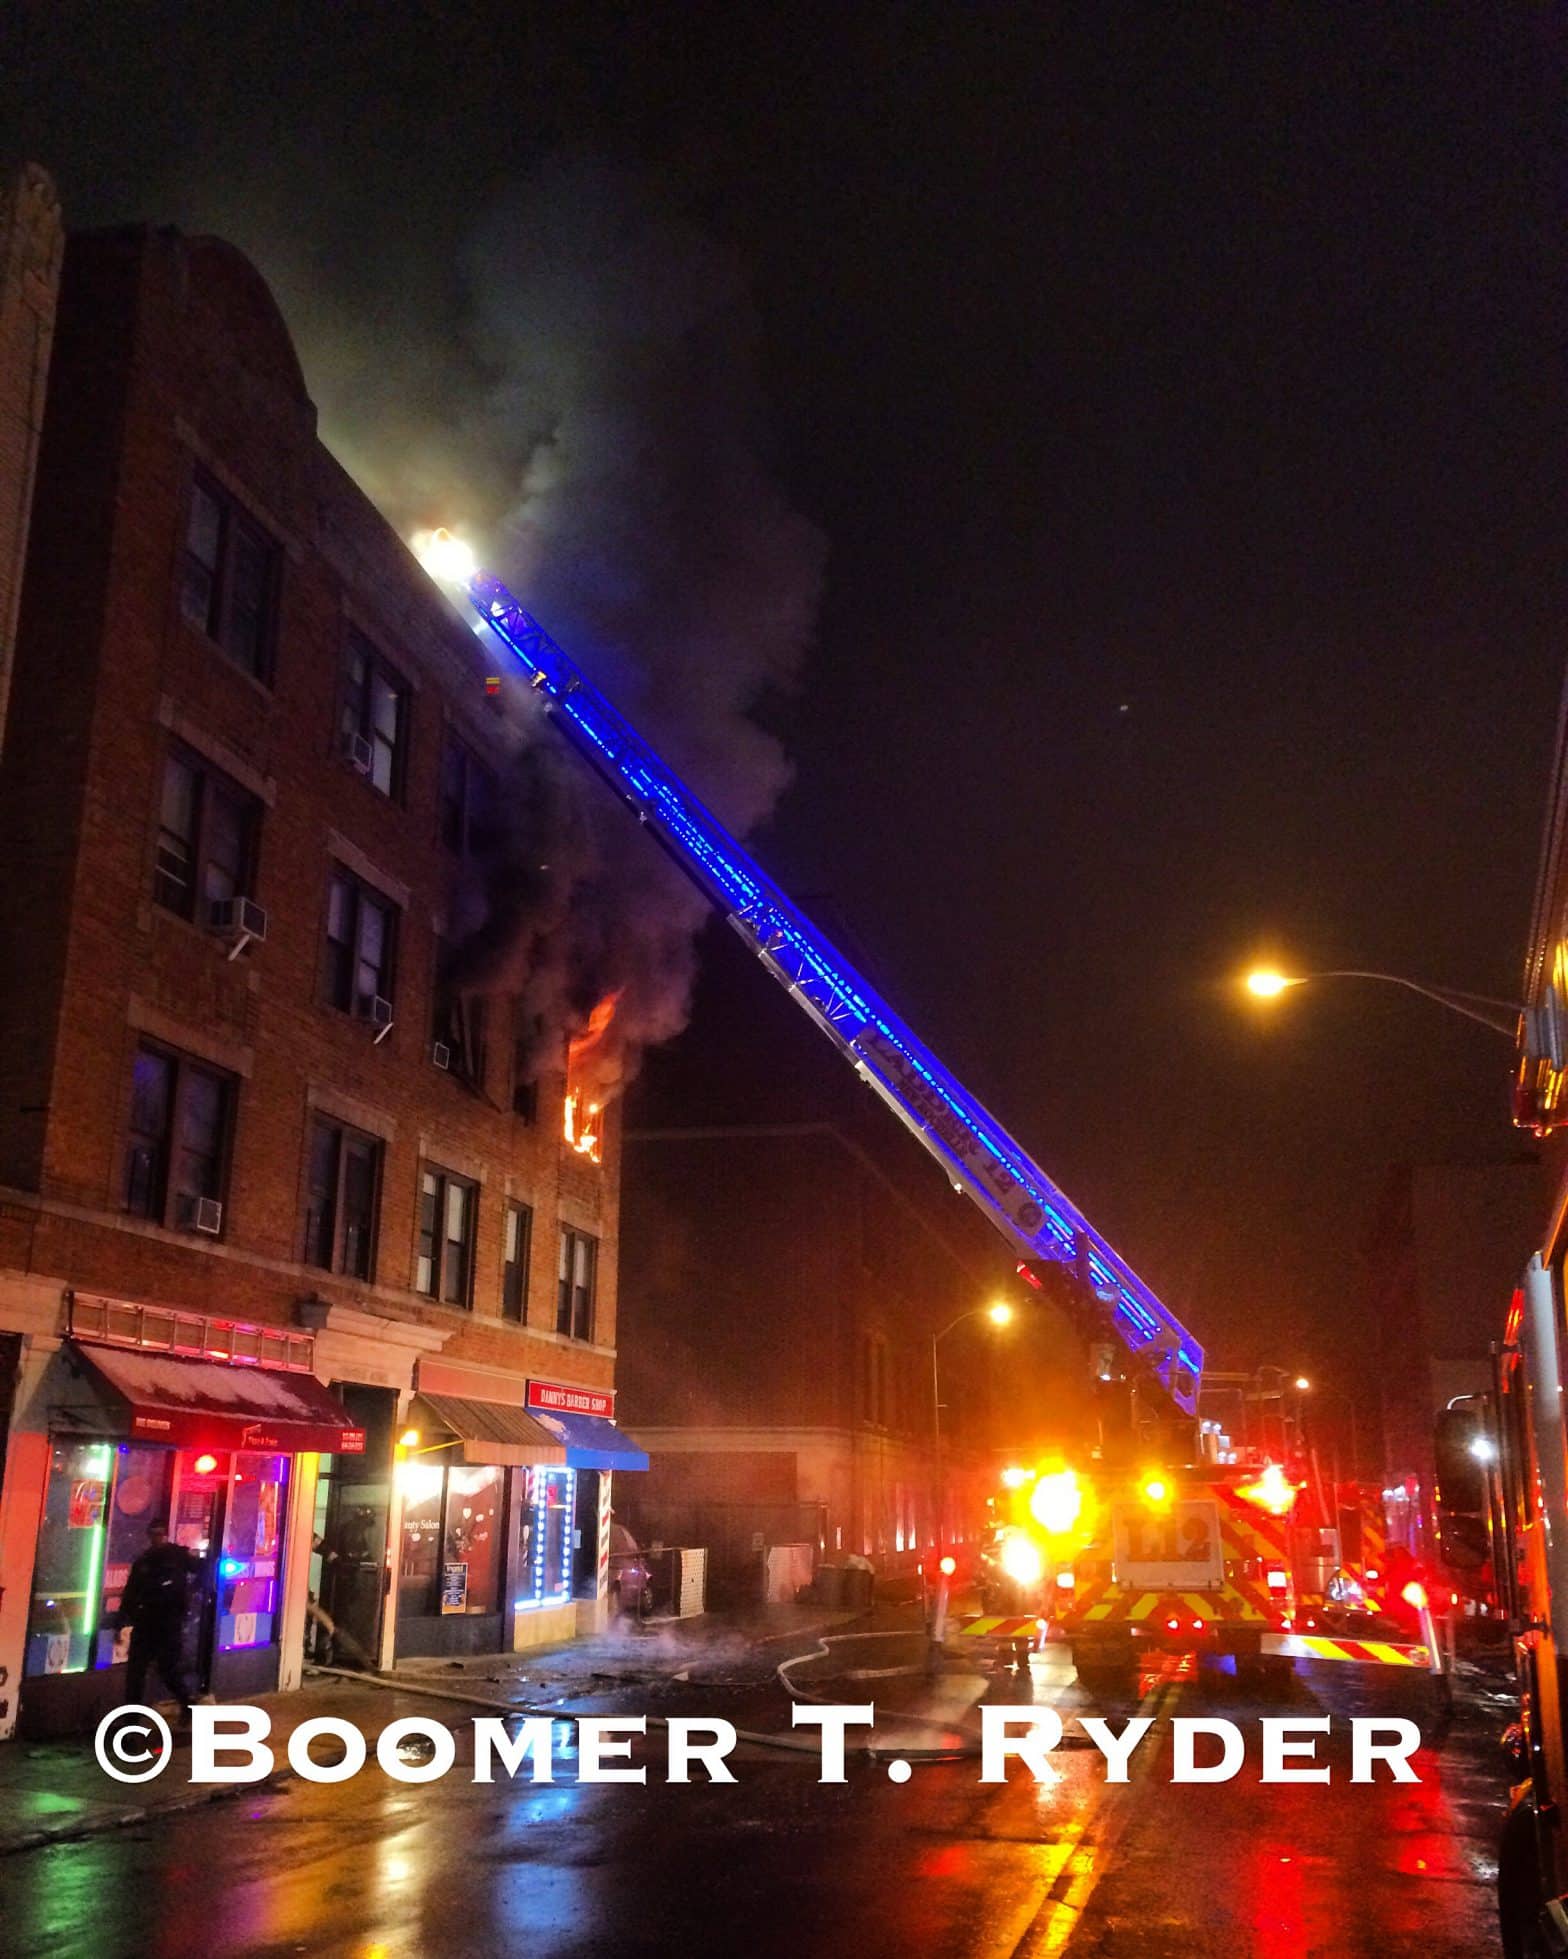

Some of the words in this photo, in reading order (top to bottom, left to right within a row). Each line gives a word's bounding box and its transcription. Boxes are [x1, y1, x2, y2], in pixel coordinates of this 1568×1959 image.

[540, 1388, 566, 1406] DANNY'S
[566, 1393, 590, 1410] BARBER
[591, 1397, 607, 1411] SHOP
